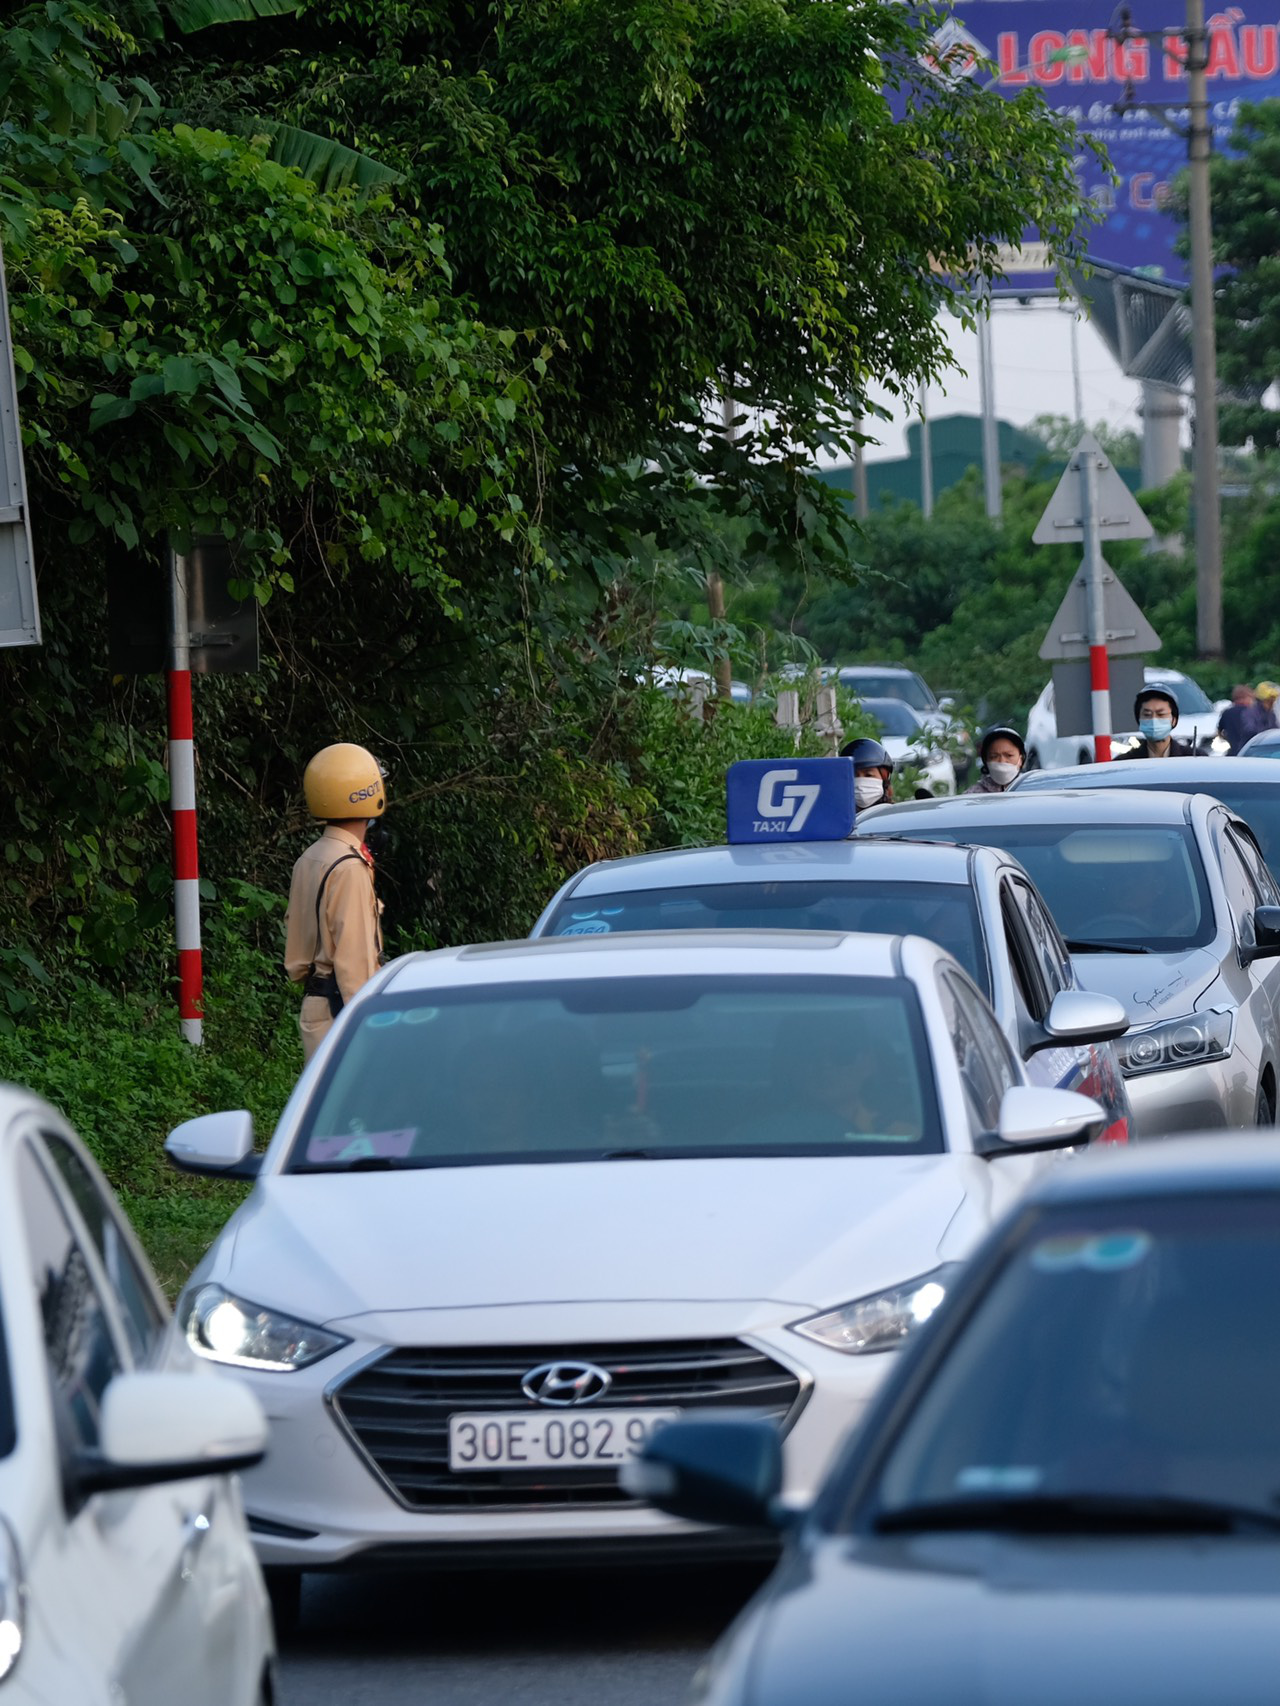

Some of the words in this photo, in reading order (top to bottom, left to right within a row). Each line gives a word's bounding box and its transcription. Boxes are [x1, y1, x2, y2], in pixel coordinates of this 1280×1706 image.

[998, 29, 1150, 84] LONG
[349, 780, 381, 803] CSGT
[757, 769, 821, 833] G7
[752, 821, 787, 833] TAXI
